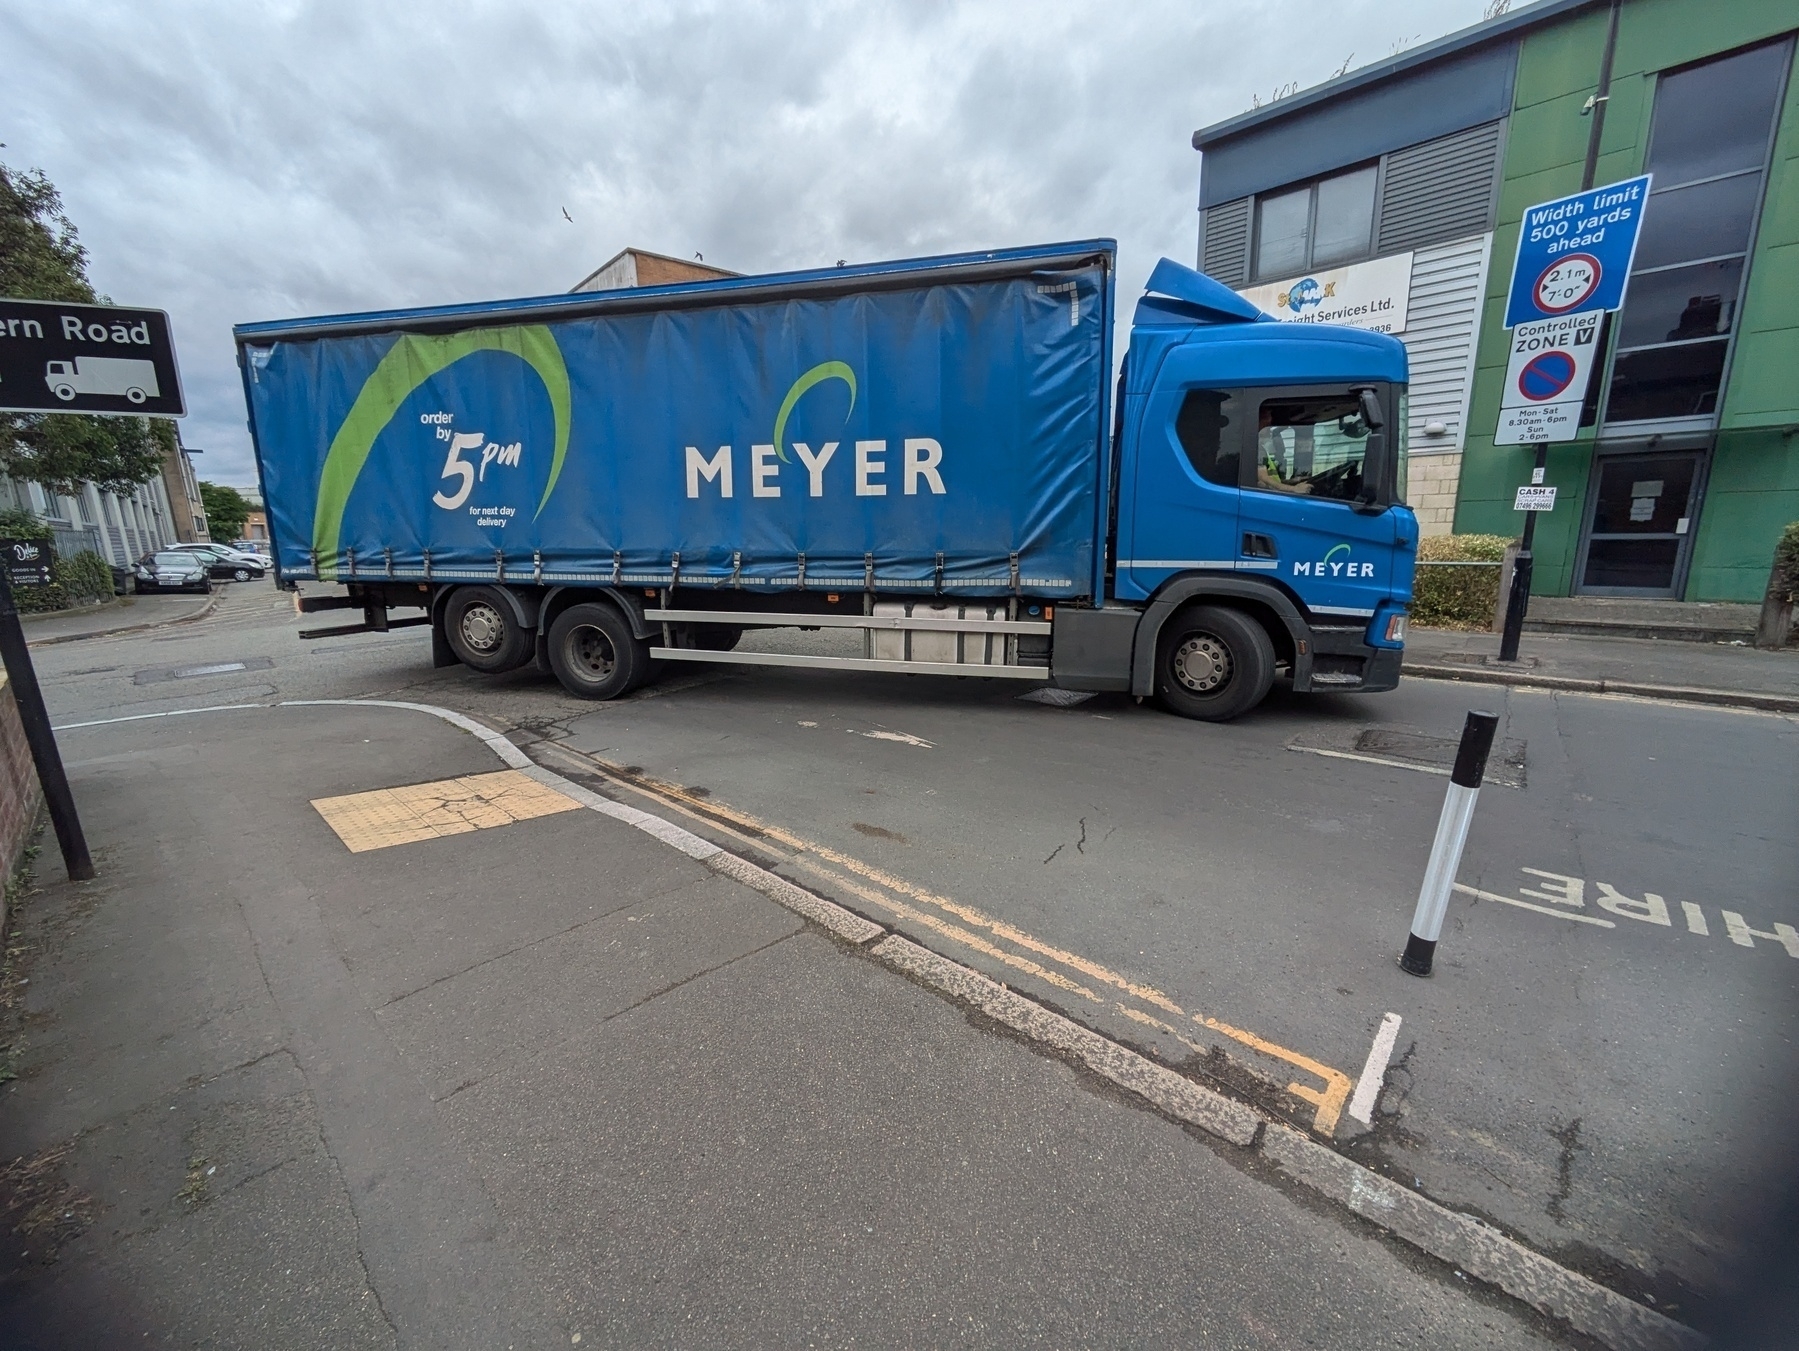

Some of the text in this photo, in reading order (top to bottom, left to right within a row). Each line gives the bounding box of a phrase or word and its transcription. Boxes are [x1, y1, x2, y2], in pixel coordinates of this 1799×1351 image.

[1531, 185, 1641, 226] Width limit
[1529, 207, 1632, 242] 500 yards
[1546, 227, 1606, 254] ahead
[1317, 304, 1368, 322] Services
[1369, 298, 1395, 313] Ltd.
[61, 315, 151, 345] Road
[1518, 314, 1597, 337] Controlled
[1515, 327, 1592, 353] ZONE V
[420, 411, 454, 424] order
[436, 426, 452, 442] by
[432, 432, 522, 510] 5pm
[685, 437, 947, 499] MEYER
[469, 506, 515, 517] for next day
[476, 517, 507, 528] delivery
[1293, 562, 1374, 578] MEYER
[1520, 867, 1799, 959] HIRE
